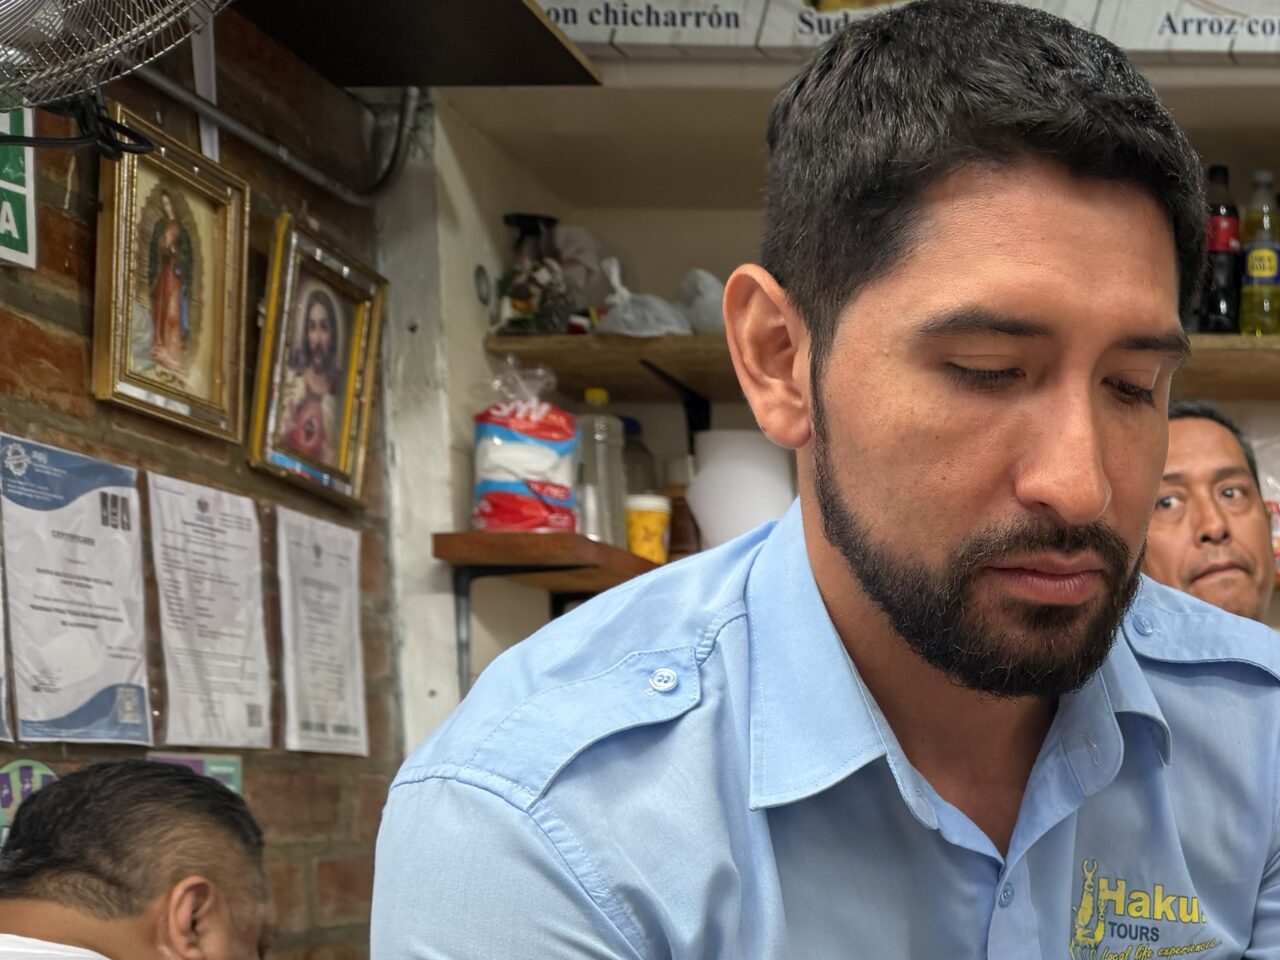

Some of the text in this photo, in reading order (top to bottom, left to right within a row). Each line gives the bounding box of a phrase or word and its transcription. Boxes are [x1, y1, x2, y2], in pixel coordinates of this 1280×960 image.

[545, 3, 741, 29] on chicharrón
[1158, 13, 1238, 36] Arroz
[1107, 921, 1161, 942] TOURS
